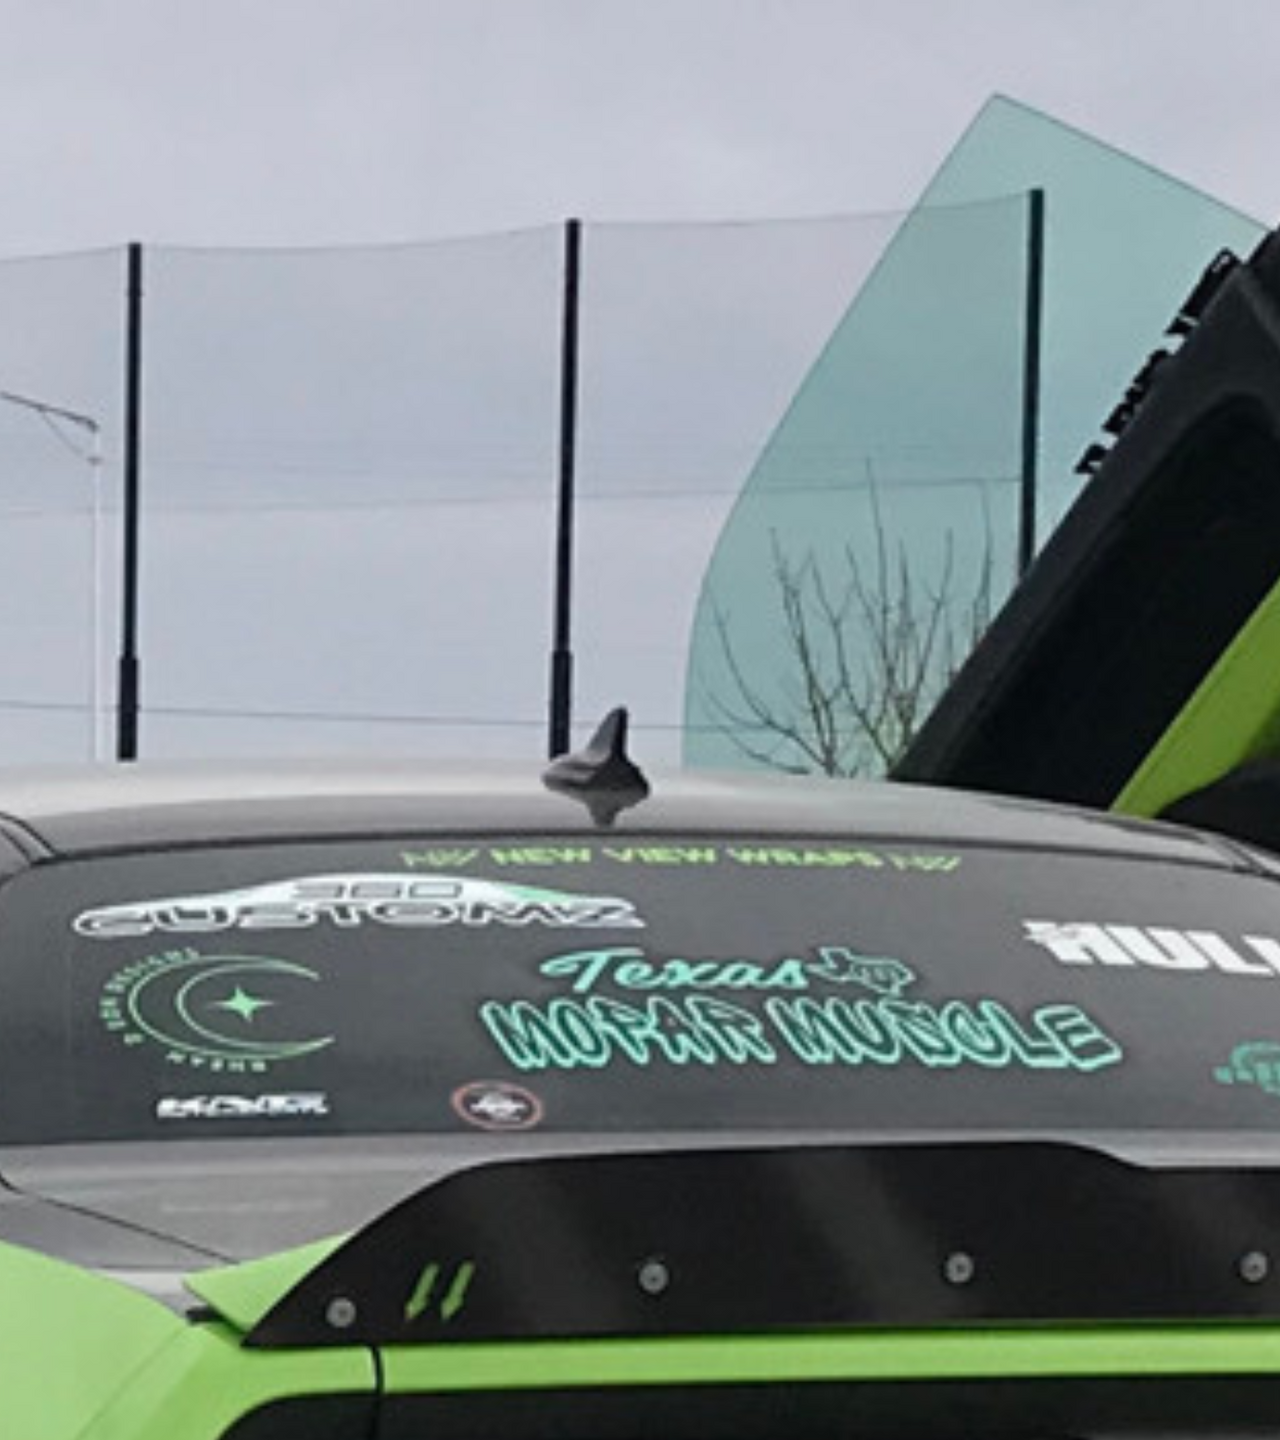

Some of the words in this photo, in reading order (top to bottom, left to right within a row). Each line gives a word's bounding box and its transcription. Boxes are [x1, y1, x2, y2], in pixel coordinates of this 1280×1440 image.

[540, 947, 810, 993] Texas
[480, 997, 775, 1069] MOPAR
[766, 997, 1122, 1072] MUSCLE
